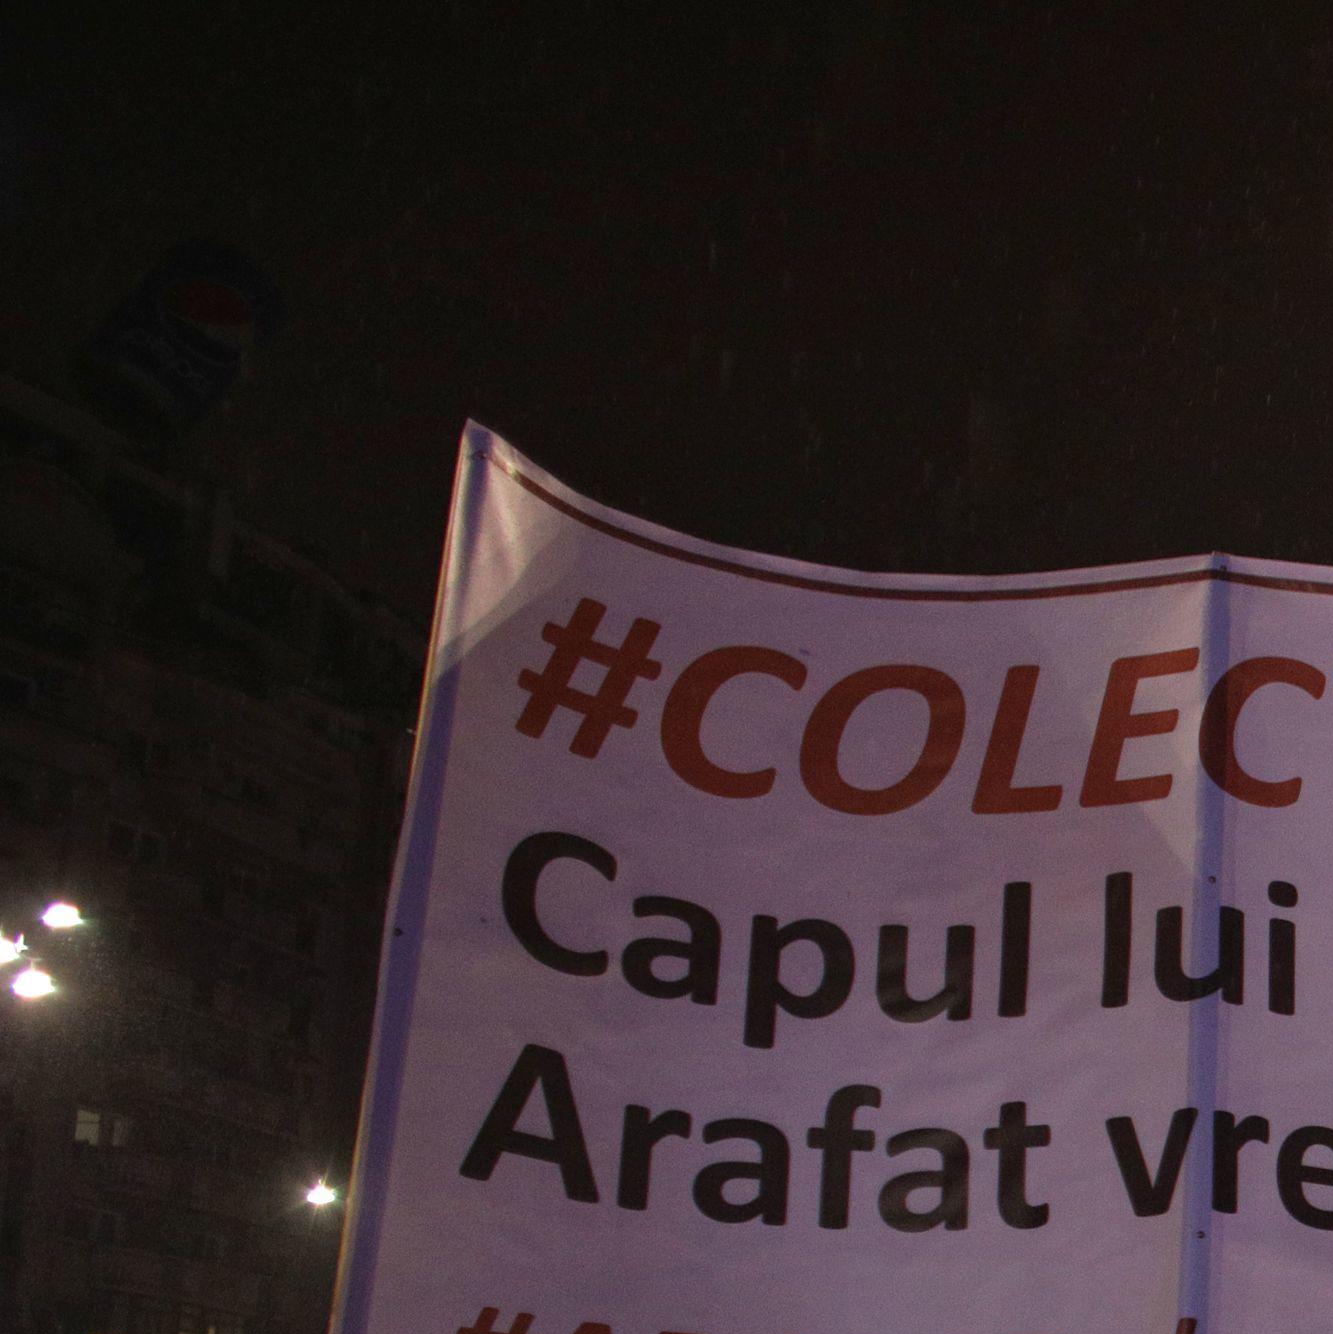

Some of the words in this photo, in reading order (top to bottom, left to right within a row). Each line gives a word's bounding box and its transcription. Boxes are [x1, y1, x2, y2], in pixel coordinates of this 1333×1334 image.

[502, 831, 1032, 1049] Capul
[1102, 871, 1298, 1016] lui
[459, 1043, 1052, 1233] Arafat
